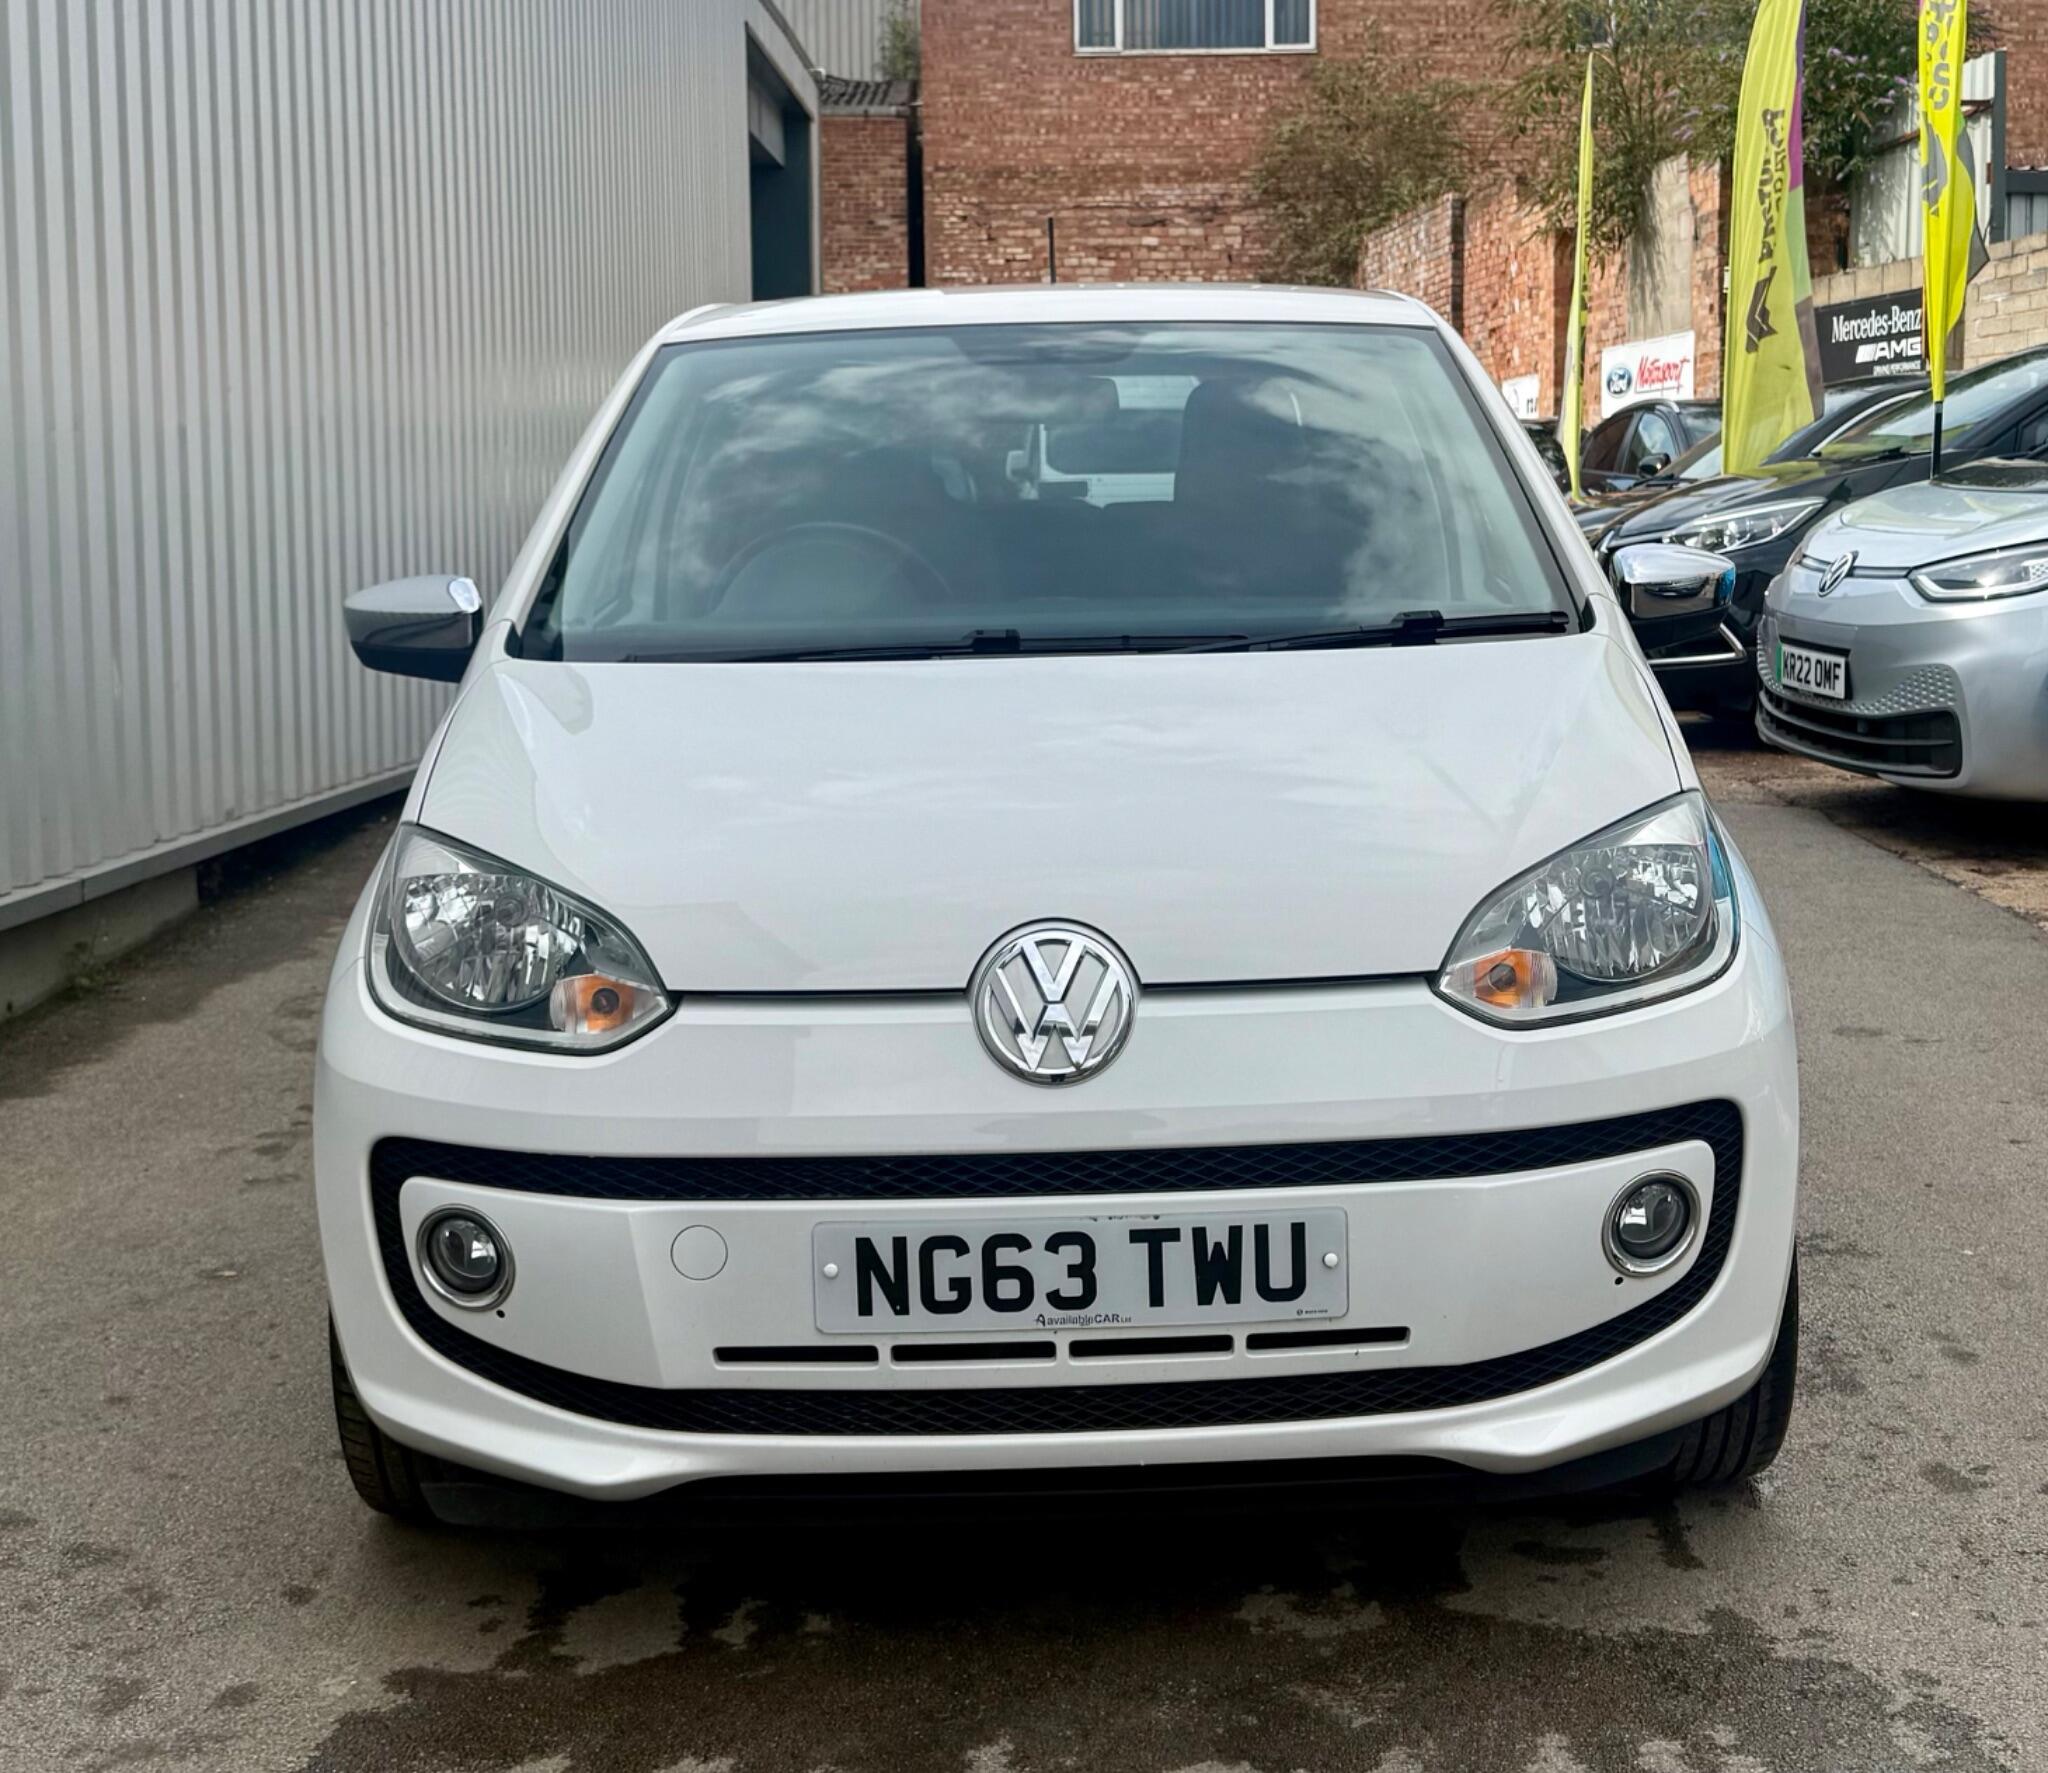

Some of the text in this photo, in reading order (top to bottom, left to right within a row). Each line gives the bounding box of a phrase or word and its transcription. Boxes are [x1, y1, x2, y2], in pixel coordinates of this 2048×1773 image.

[1831, 304, 1922, 343] Mercedes-Benz
[1874, 336, 1921, 361] AMG
[1783, 650, 1841, 691] KR22 OMF
[855, 1221, 1307, 1317] NG63 TWU
